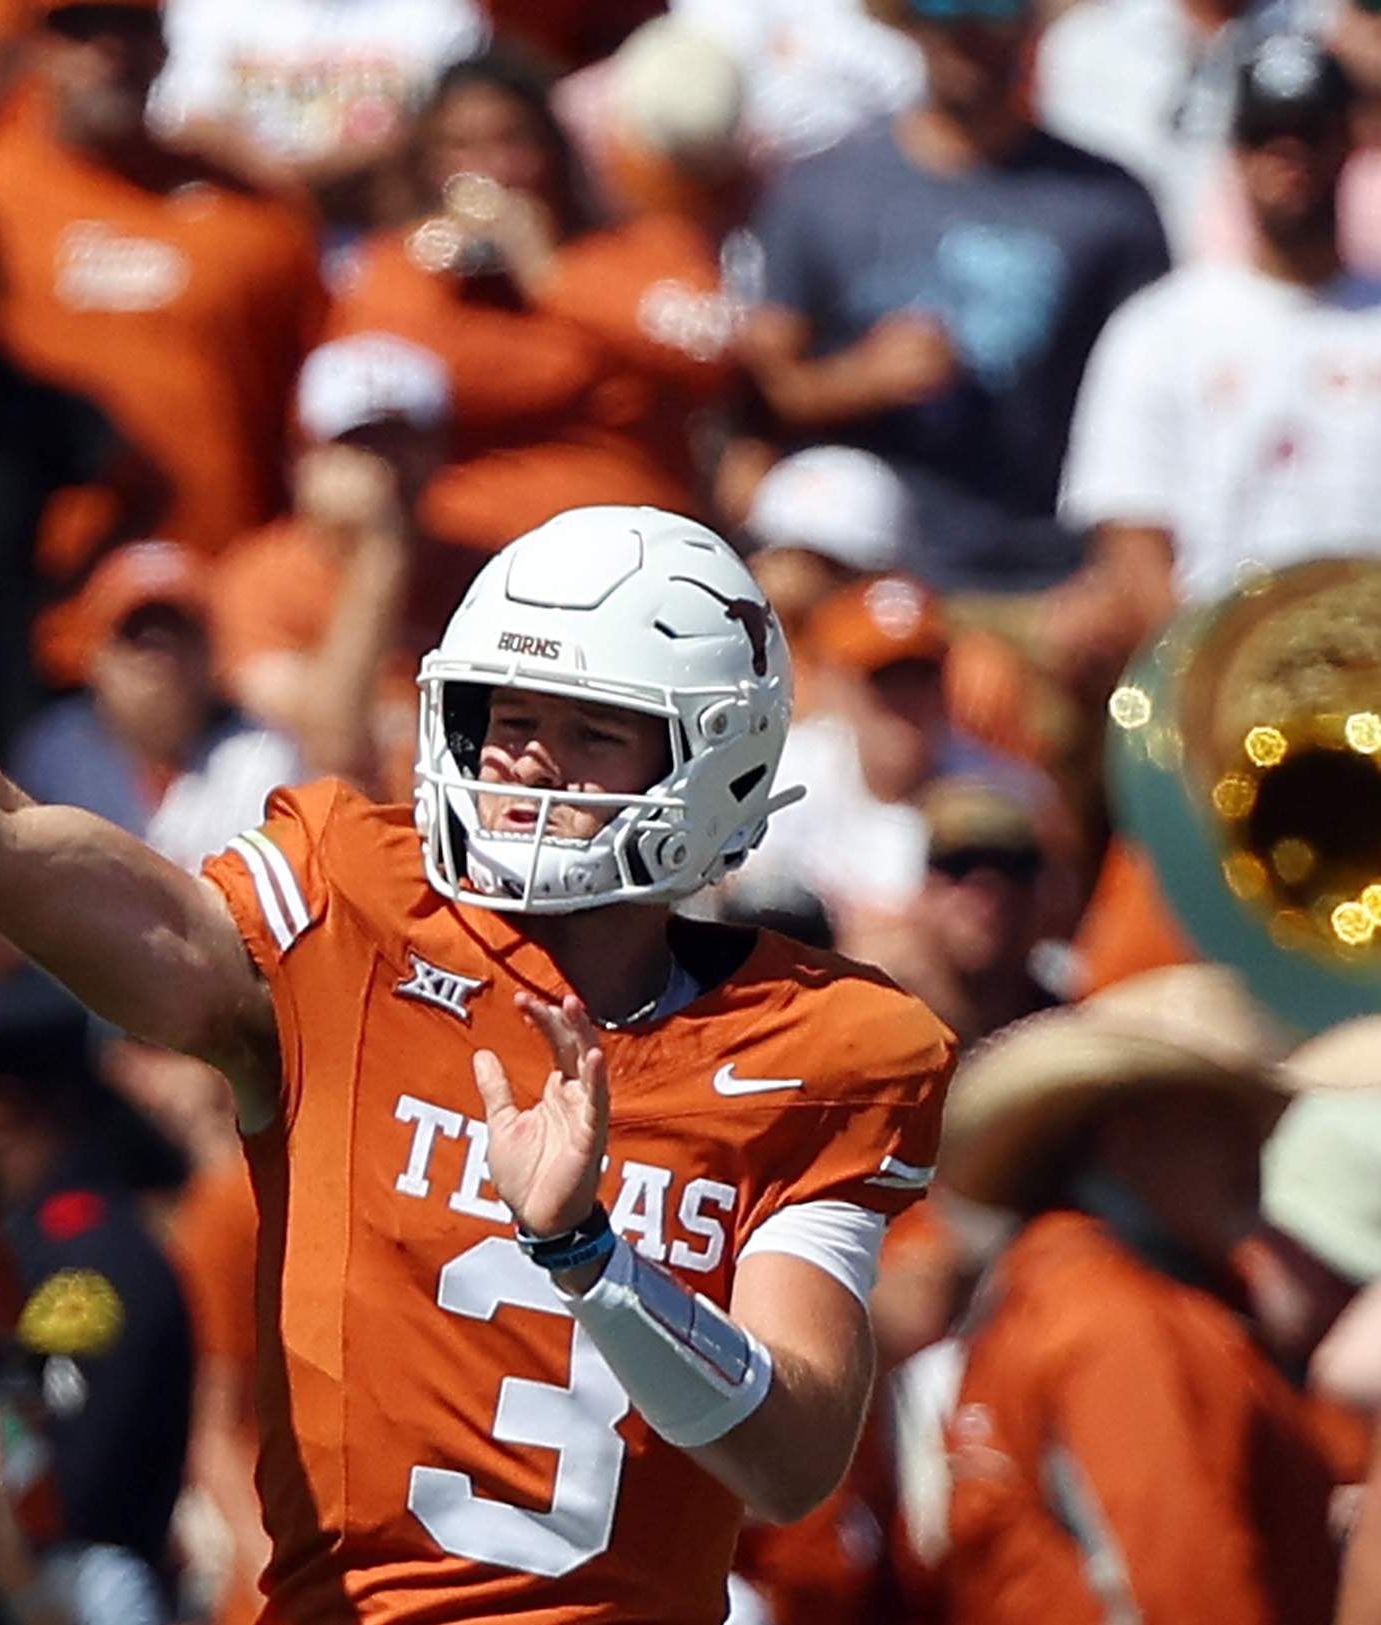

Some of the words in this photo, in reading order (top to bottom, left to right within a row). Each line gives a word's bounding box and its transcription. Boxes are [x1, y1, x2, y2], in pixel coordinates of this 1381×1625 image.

[497, 630, 562, 661] HORNS
[394, 950, 486, 1021] XII
[395, 1094, 737, 1274] TEAS
[407, 1236, 631, 1579] 3
